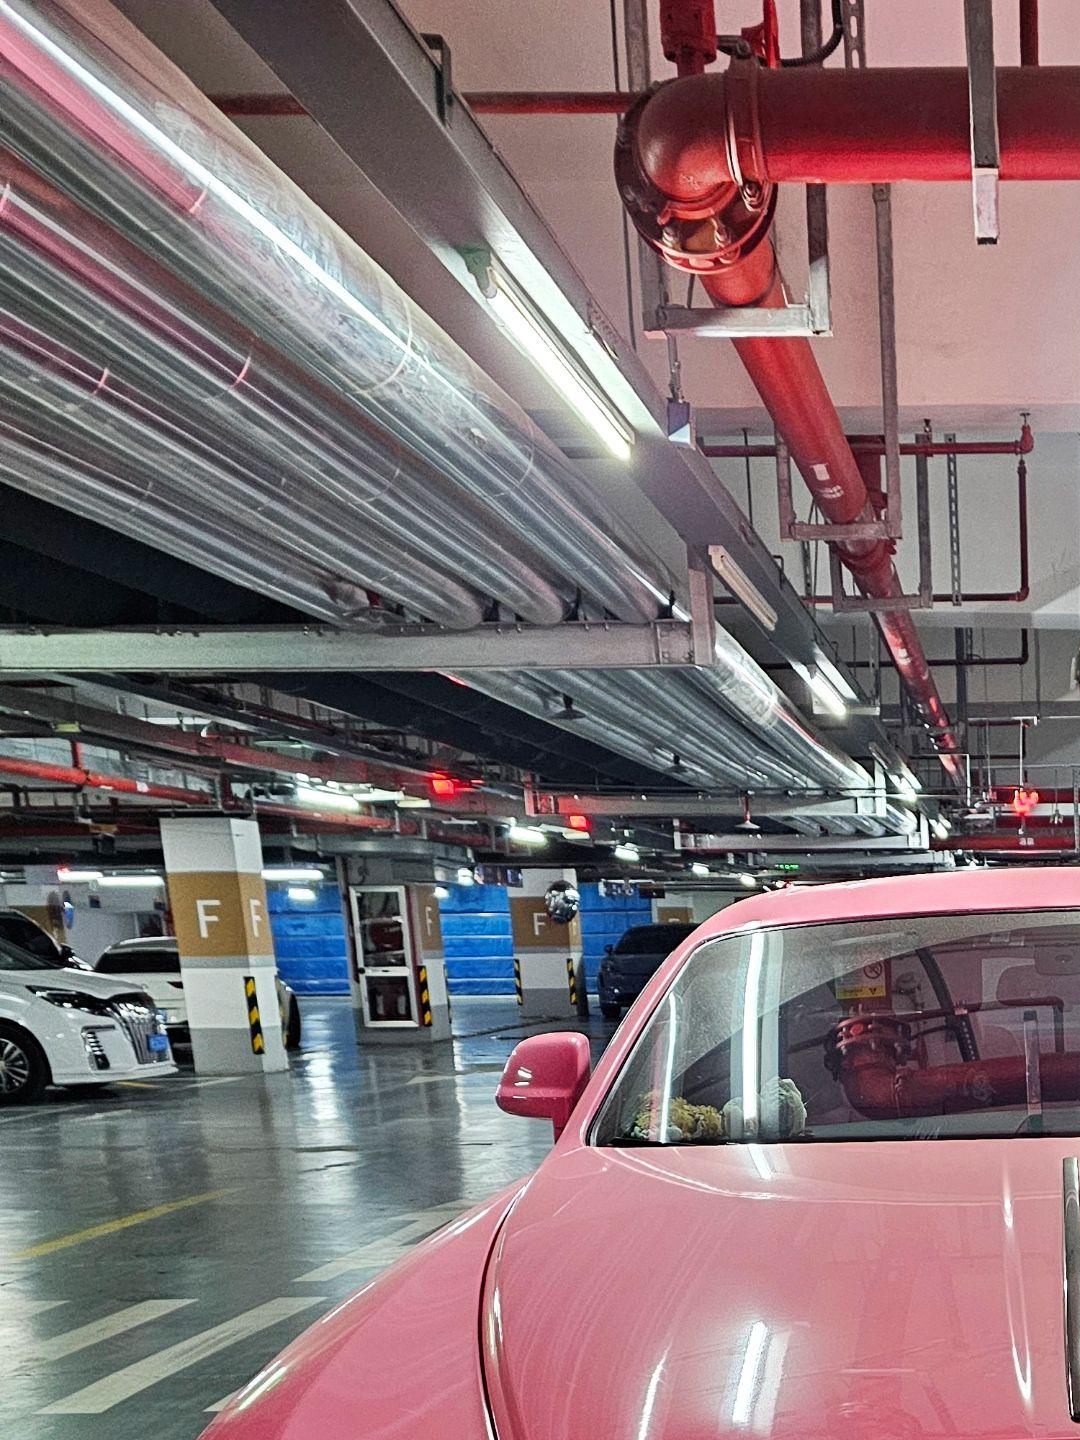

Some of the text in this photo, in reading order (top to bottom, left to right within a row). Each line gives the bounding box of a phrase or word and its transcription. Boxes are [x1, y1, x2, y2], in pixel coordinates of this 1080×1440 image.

[196, 899, 221, 939] F
[249, 898, 262, 939] F
[533, 912, 547, 936] F
